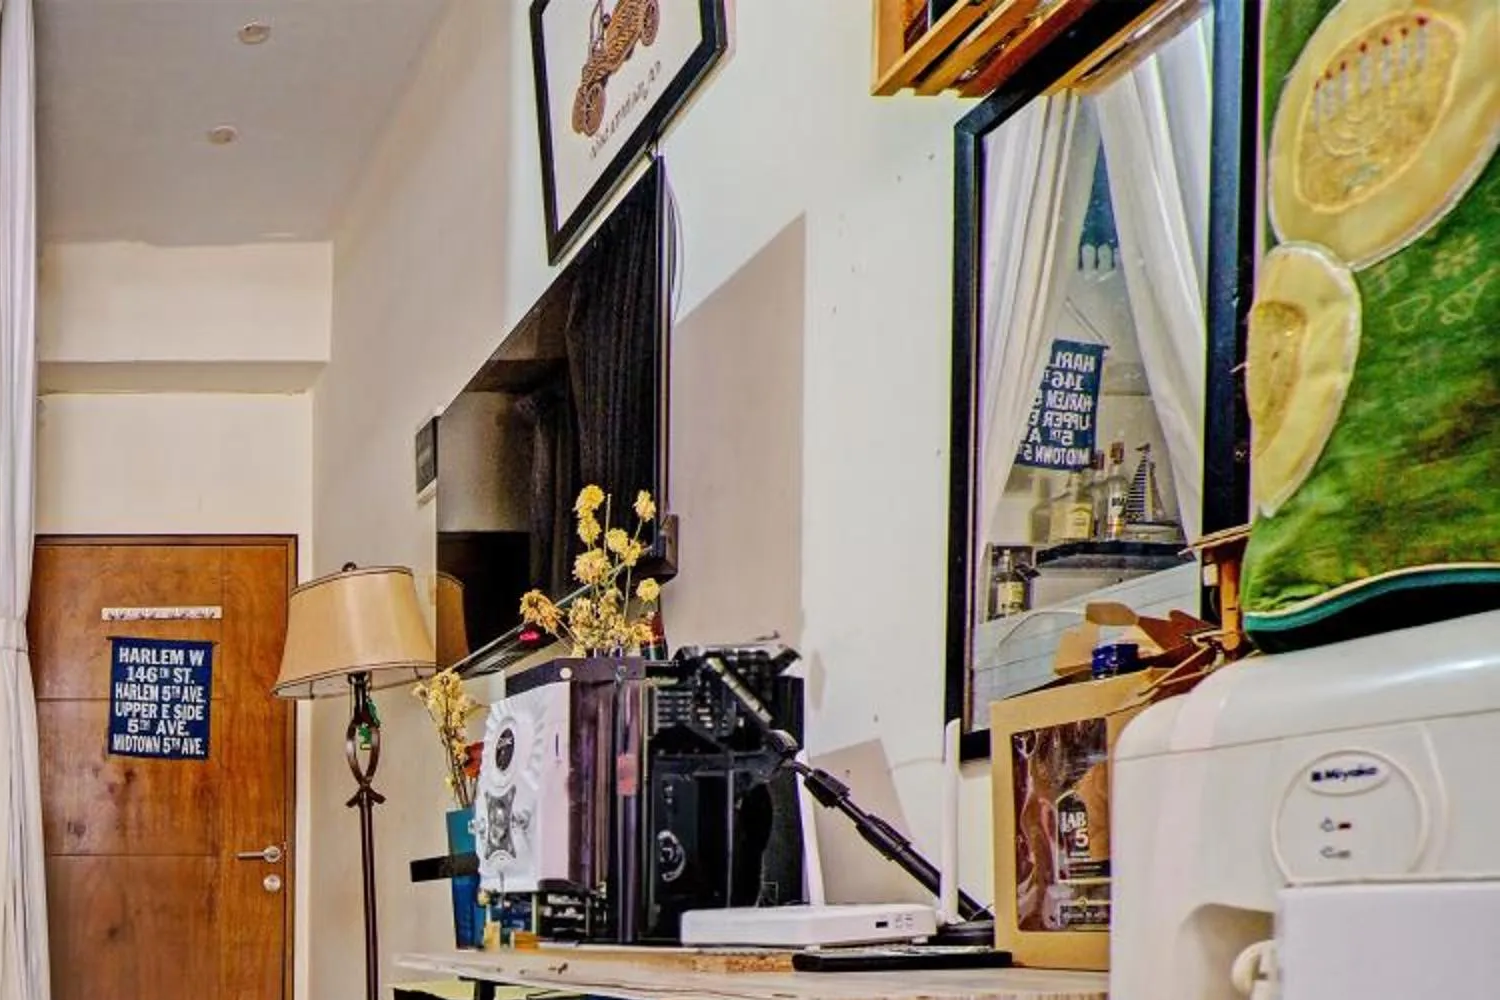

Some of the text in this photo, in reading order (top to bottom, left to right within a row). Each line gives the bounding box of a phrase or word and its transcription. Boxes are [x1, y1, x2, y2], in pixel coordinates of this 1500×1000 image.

[119, 647, 204, 666] HARLEM W
[126, 666, 195, 684] 146TH ST.
[115, 682, 207, 703] HARLEM 5TH AVE.
[115, 701, 204, 720] UPPER E SIDE
[127, 719, 190, 736] 5TH AVE.
[113, 733, 205, 755] MIDTOWN 5TH AVE.
